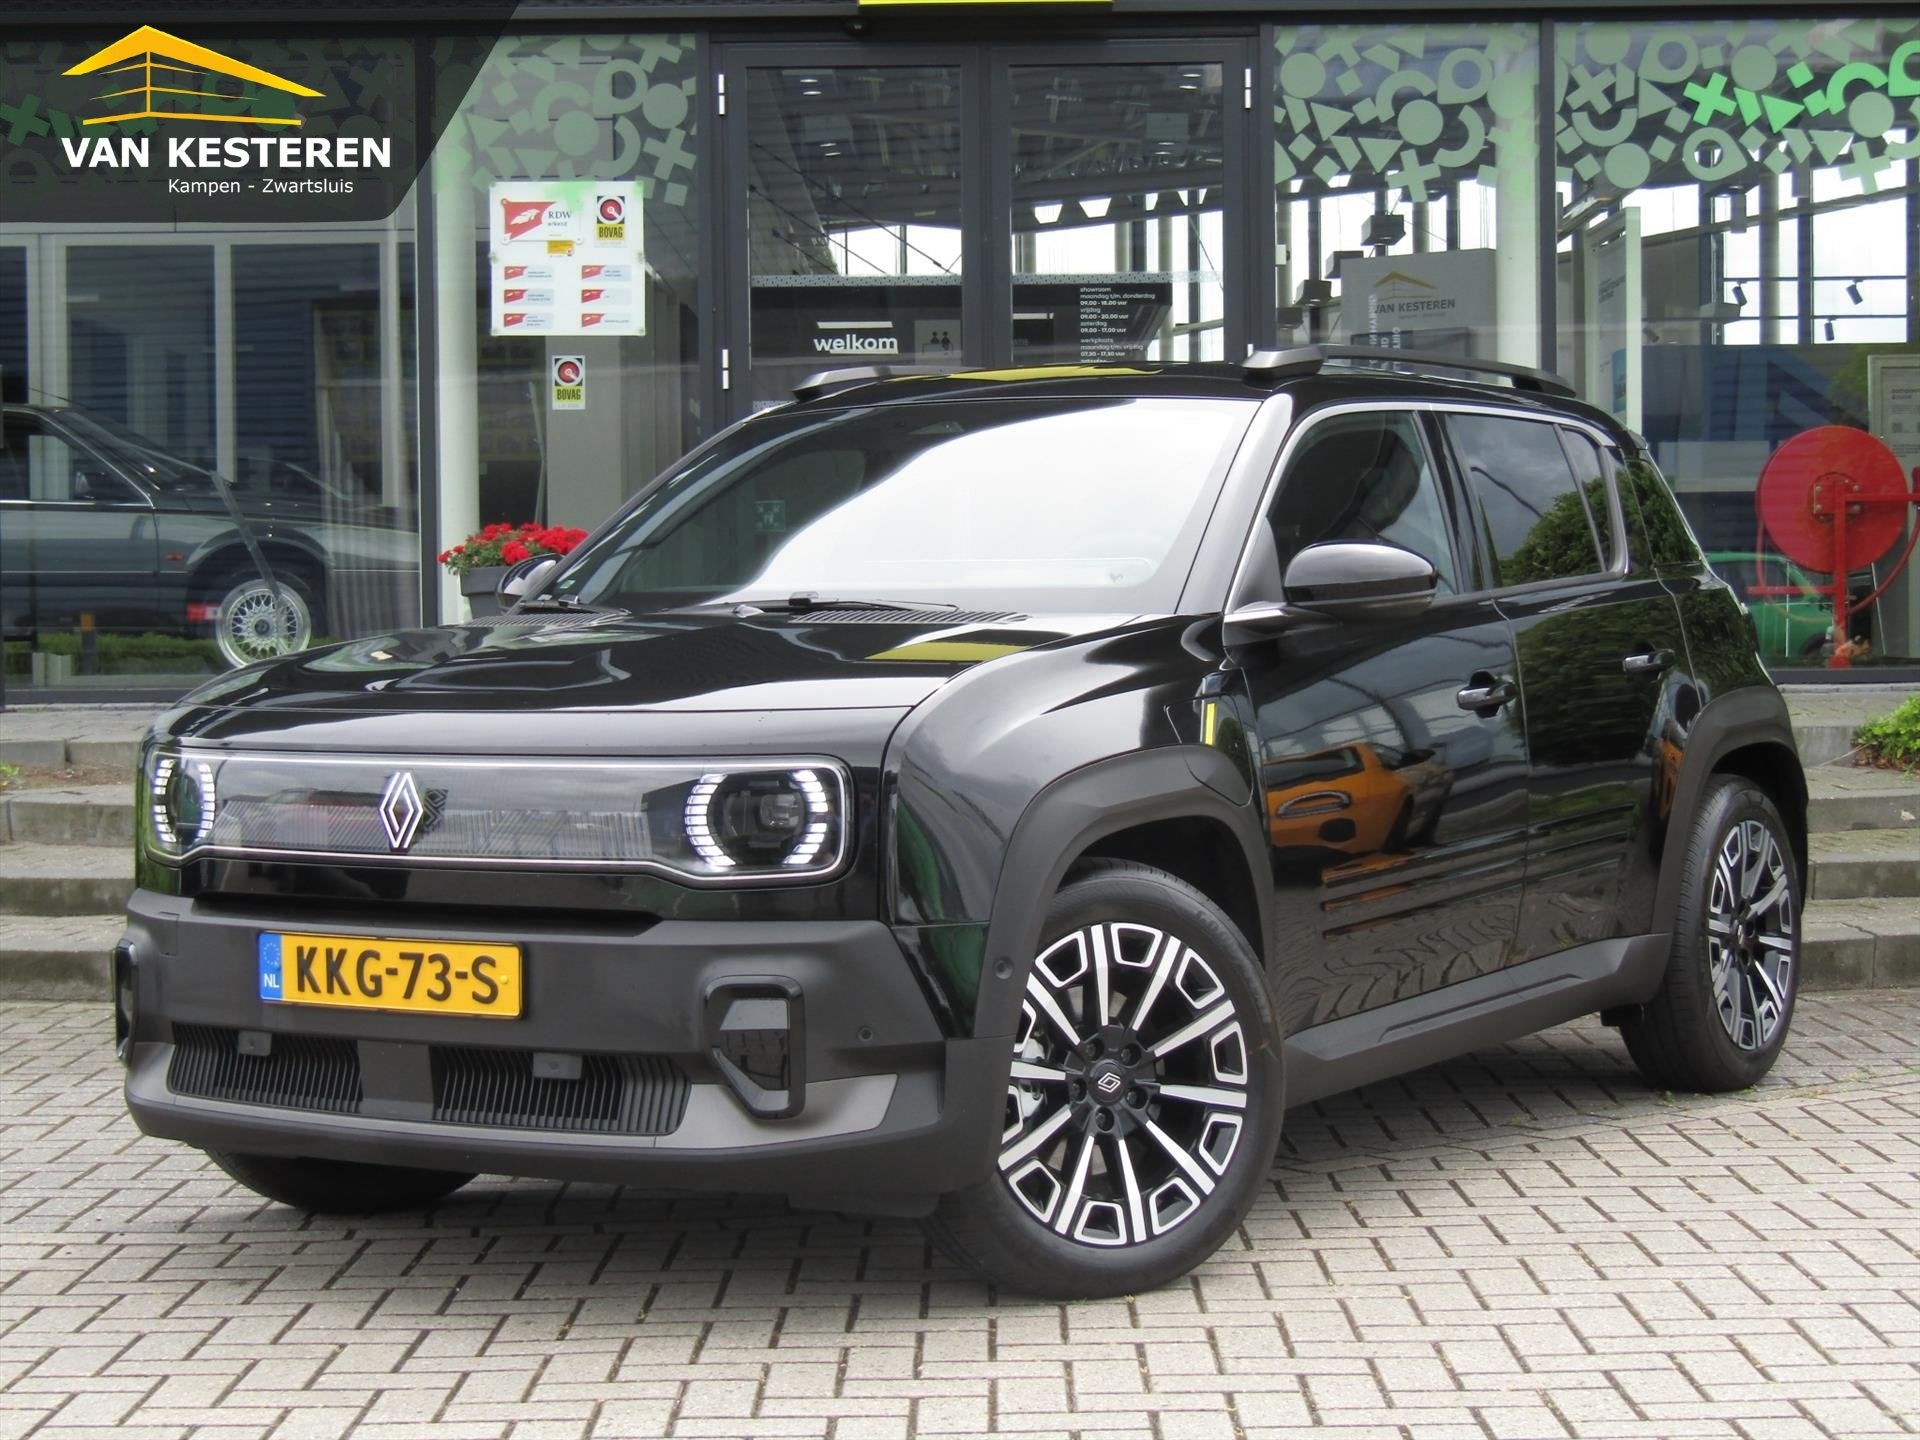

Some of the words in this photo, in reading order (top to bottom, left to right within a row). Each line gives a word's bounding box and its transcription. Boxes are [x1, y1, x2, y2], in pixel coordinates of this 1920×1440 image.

[548, 210, 571, 220] RDW
[599, 226, 623, 238] BOVAG
[1398, 299, 1456, 312] KESTEREN
[814, 334, 898, 351] welkom
[556, 389, 582, 400] BOVAG
[264, 973, 279, 989] NL
[296, 945, 499, 1005] KKG-73-S
